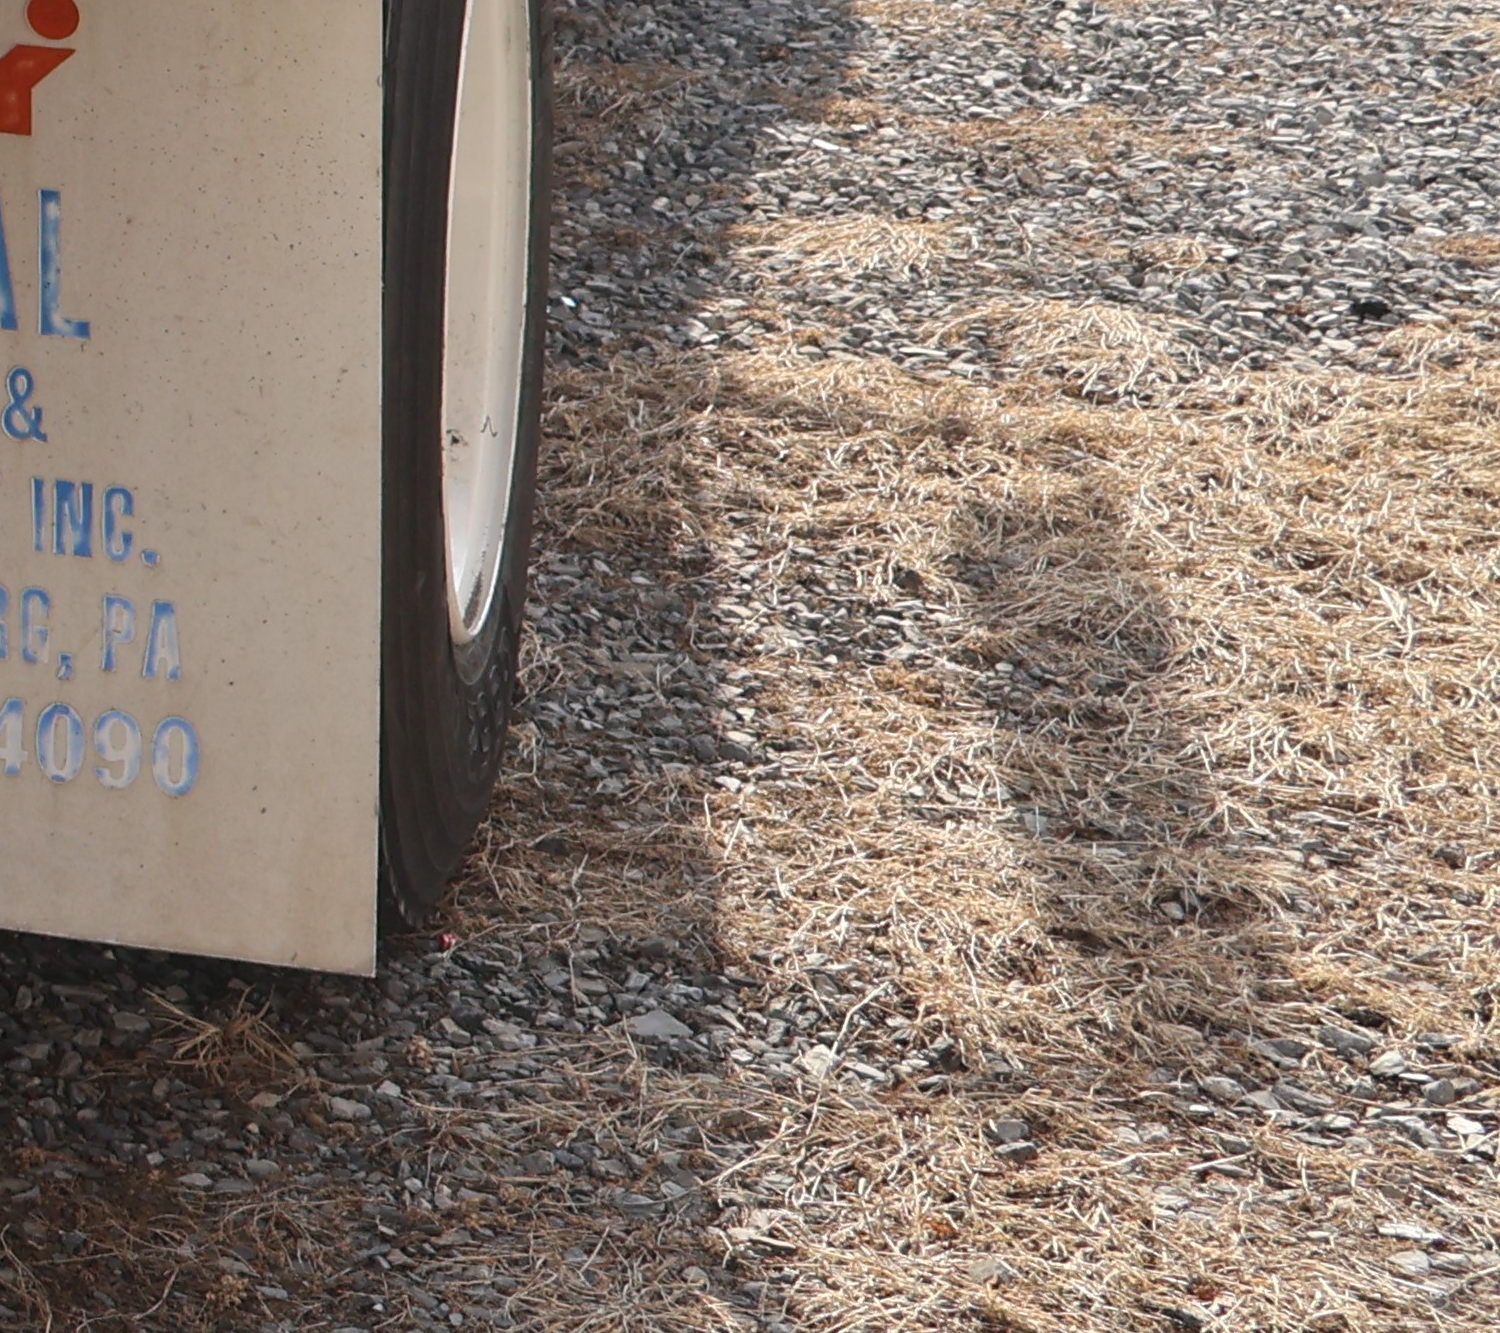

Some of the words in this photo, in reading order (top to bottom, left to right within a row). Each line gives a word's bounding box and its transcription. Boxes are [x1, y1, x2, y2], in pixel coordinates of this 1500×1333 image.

[1, 365, 48, 445] &
[30, 475, 163, 566] INC.
[99, 590, 181, 682] PA
